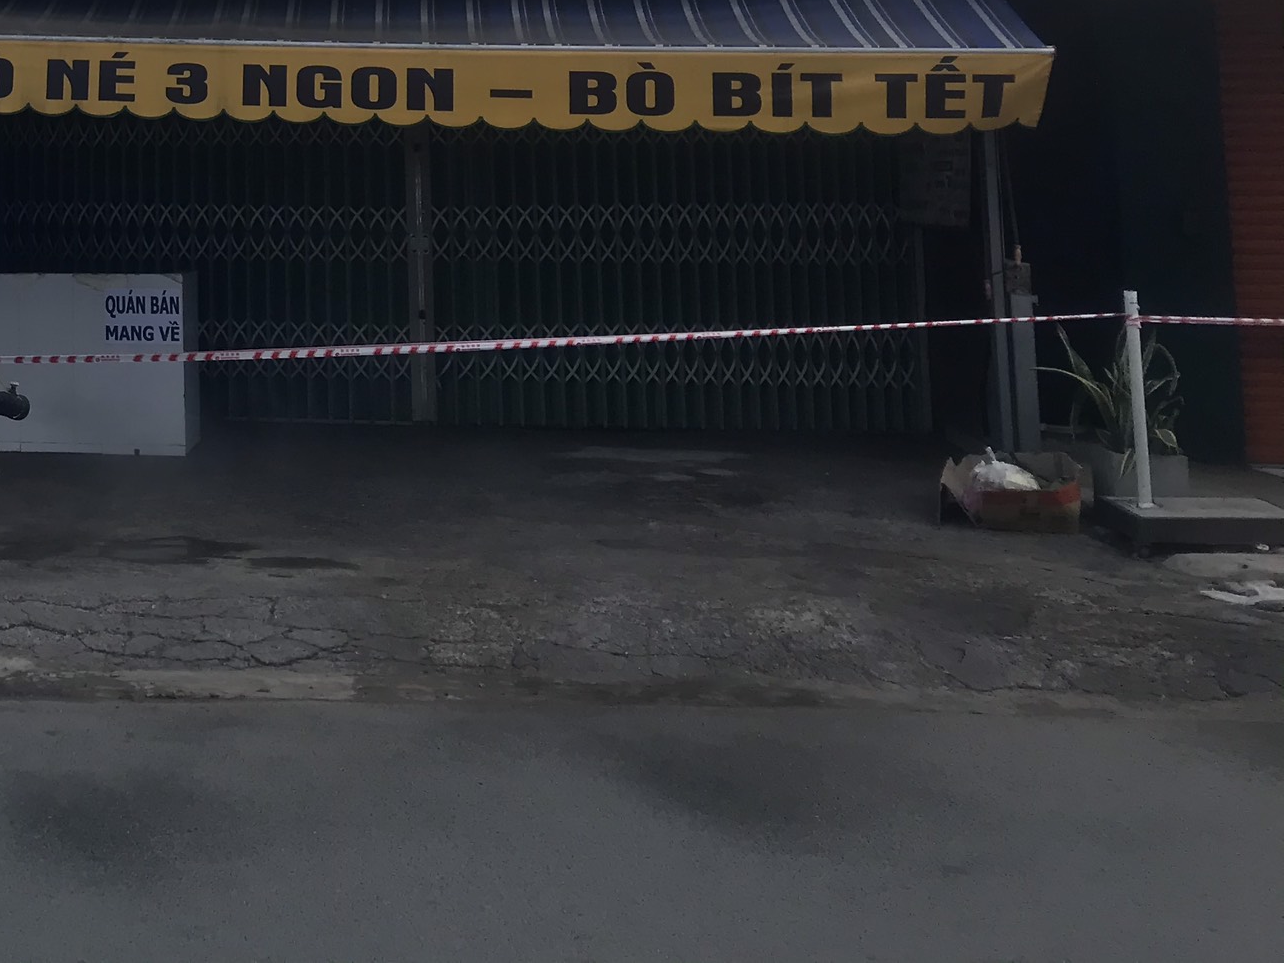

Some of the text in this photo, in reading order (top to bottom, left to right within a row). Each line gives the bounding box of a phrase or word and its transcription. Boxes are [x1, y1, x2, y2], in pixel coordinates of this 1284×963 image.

[46, 51, 136, 102] NÉ
[165, 62, 209, 105] 3
[242, 63, 454, 112] NGON
[568, 61, 676, 117] BÒ
[712, 62, 843, 118] BÍT
[874, 55, 1015, 119] TẾT
[105, 288, 180, 319] QUÁN BÁN
[105, 320, 181, 342] MANG VỀ
